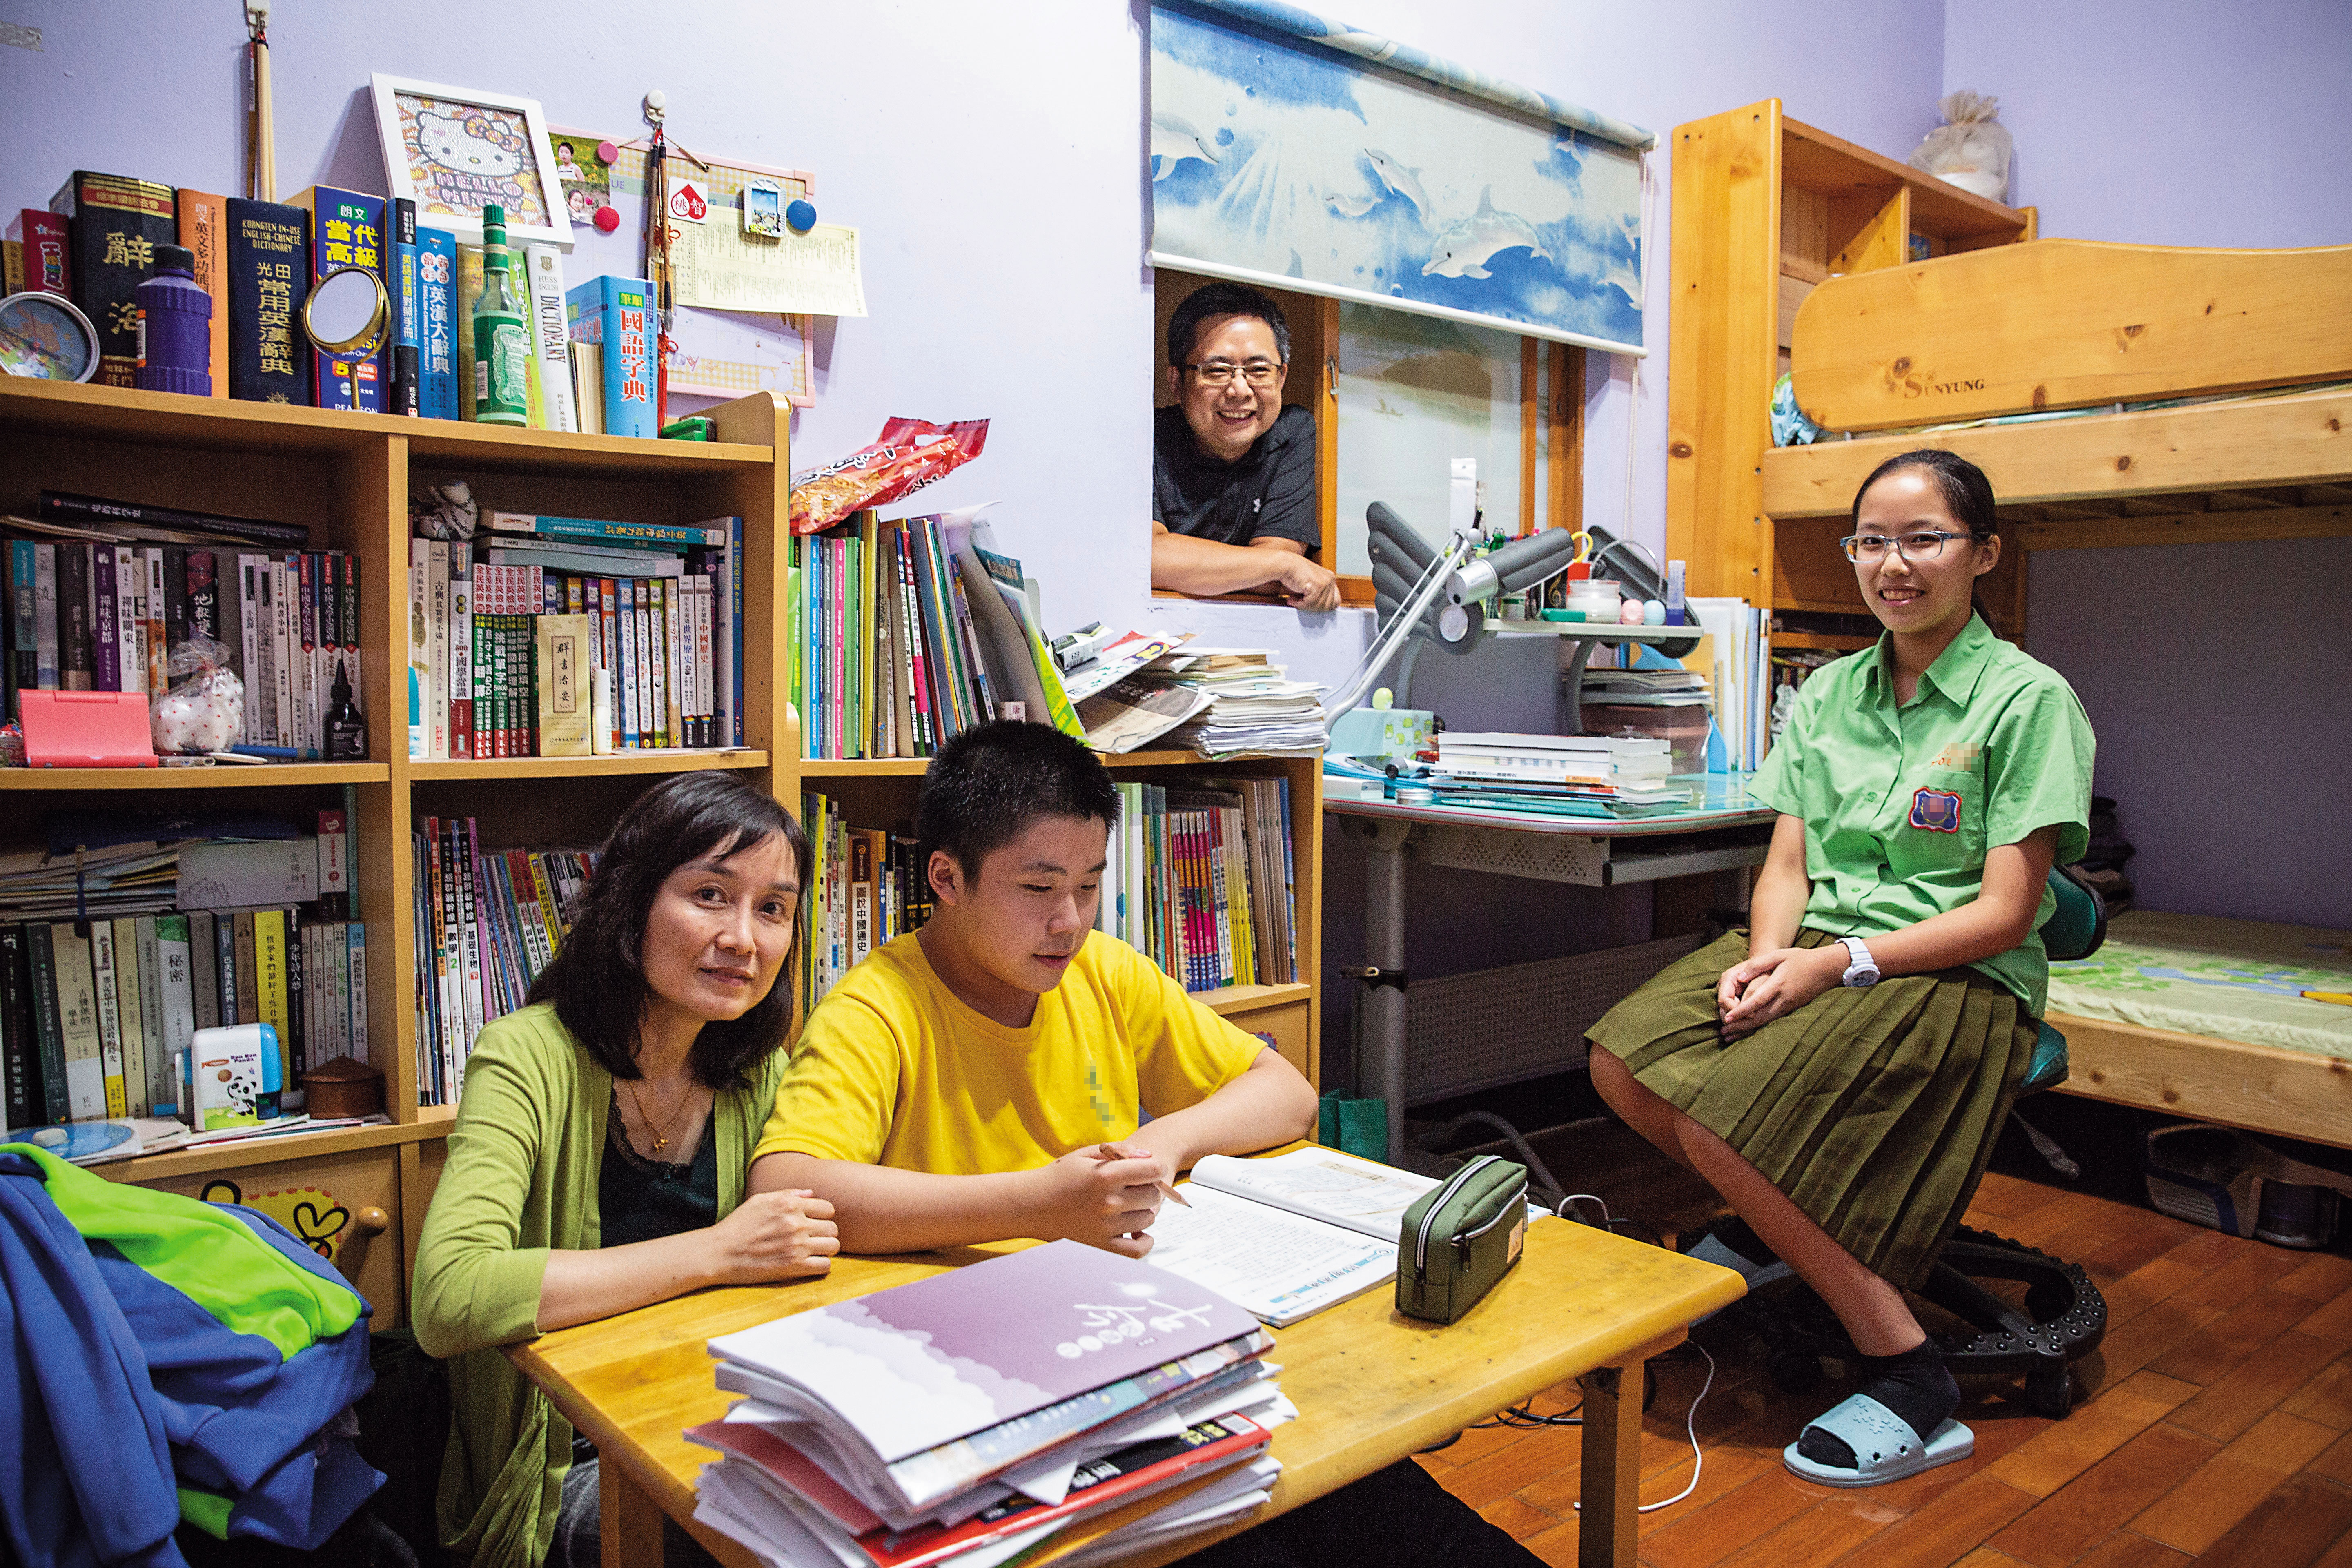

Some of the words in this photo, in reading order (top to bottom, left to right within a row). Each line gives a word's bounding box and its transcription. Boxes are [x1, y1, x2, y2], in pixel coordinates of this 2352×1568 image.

[340, 204, 365, 221] 朗文
[242, 229, 301, 245] ENGLISH-CHINESE
[252, 238, 292, 253] DICTIONARY
[325, 220, 379, 247] 當代
[325, 241, 379, 268] 高級
[257, 261, 291, 280] 光田
[538, 275, 558, 284] HESS
[258, 278, 294, 376] 常用英漢辭典
[429, 286, 450, 374] 英漢大辭典
[540, 294, 566, 364] DICTIONARY
[620, 308, 647, 403] 國語字典
[1903, 372, 1985, 399] SUNYUNG
[335, 403, 379, 414] PEASON
[494, 566, 504, 603] 全民英檢
[533, 566, 542, 602] 全民英檢
[169, 954, 183, 983] 秘密
[450, 958, 458, 969] 2
